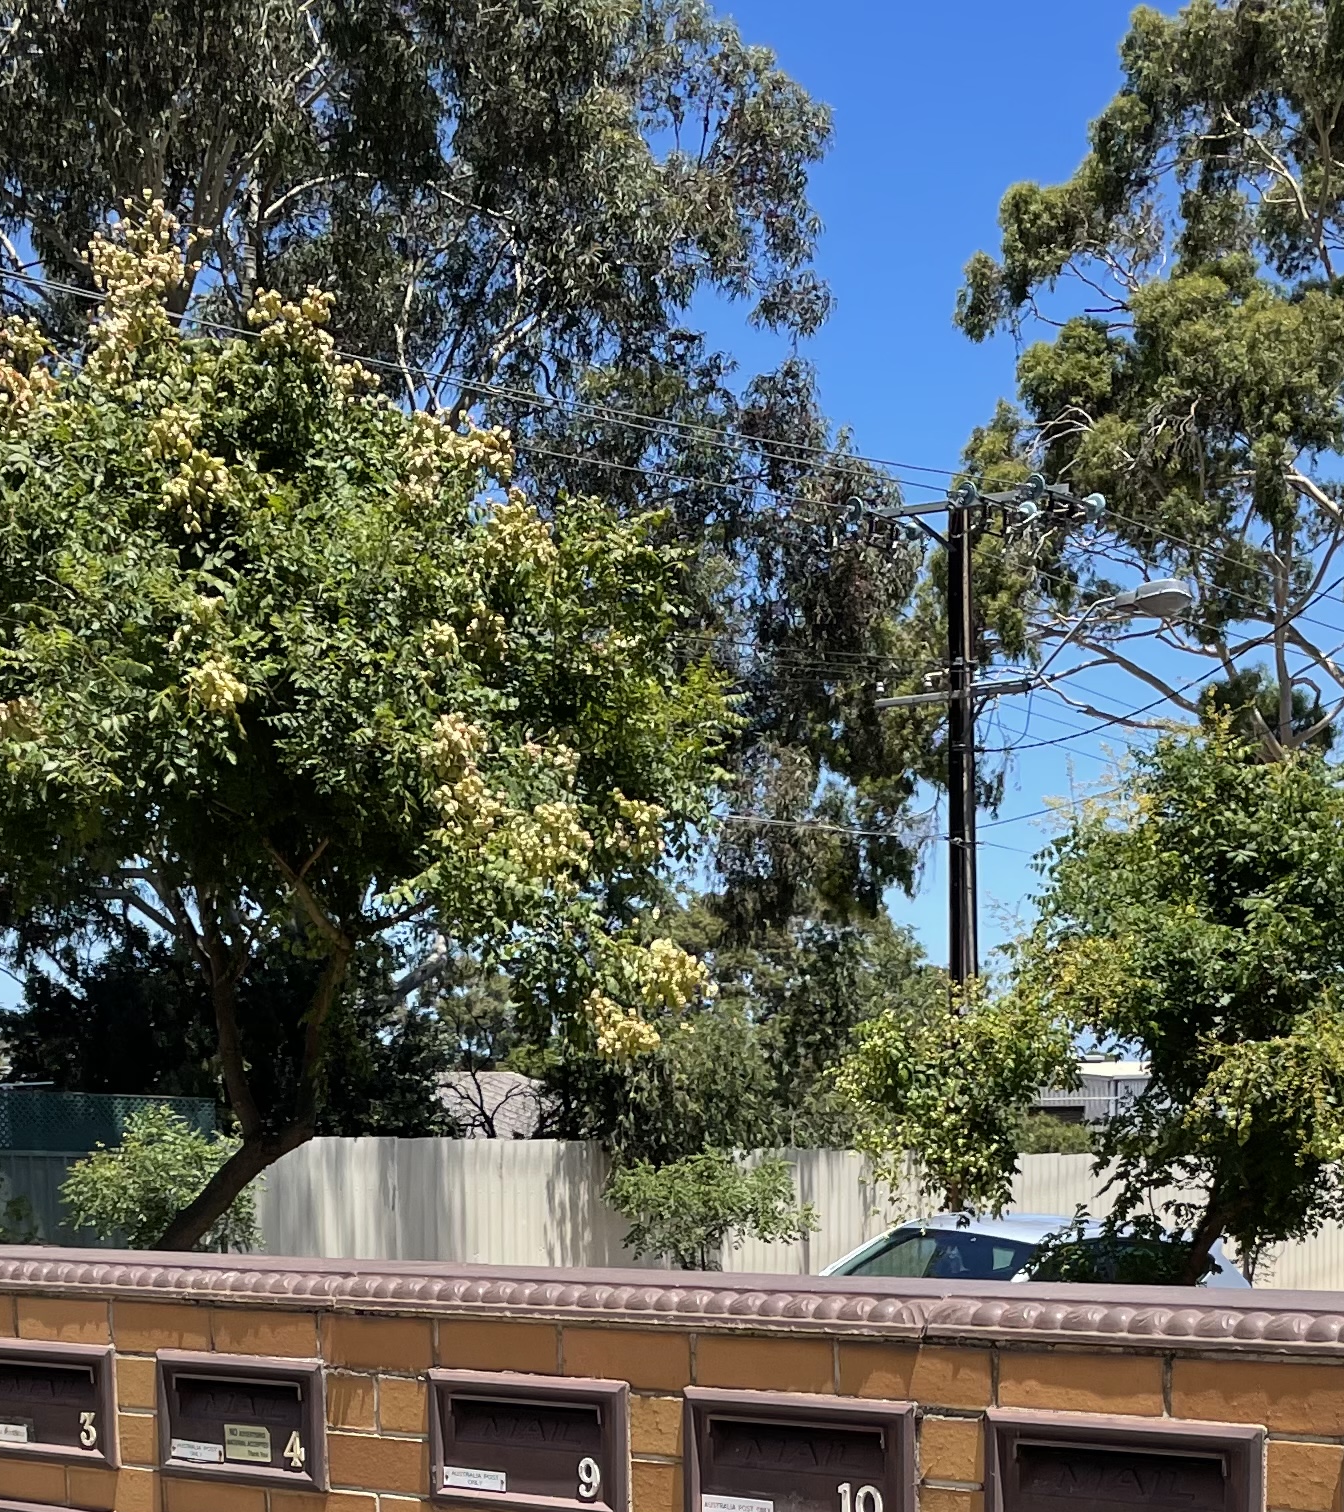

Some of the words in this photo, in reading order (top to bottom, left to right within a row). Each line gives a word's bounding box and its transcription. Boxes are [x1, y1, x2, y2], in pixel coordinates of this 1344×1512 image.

[79, 1412, 97, 1447] 3
[283, 1430, 305, 1468] 4
[577, 1456, 601, 1498] 9
[704, 1502, 735, 1510] AUSTRALIA
[738, 1504, 753, 1512] POST
